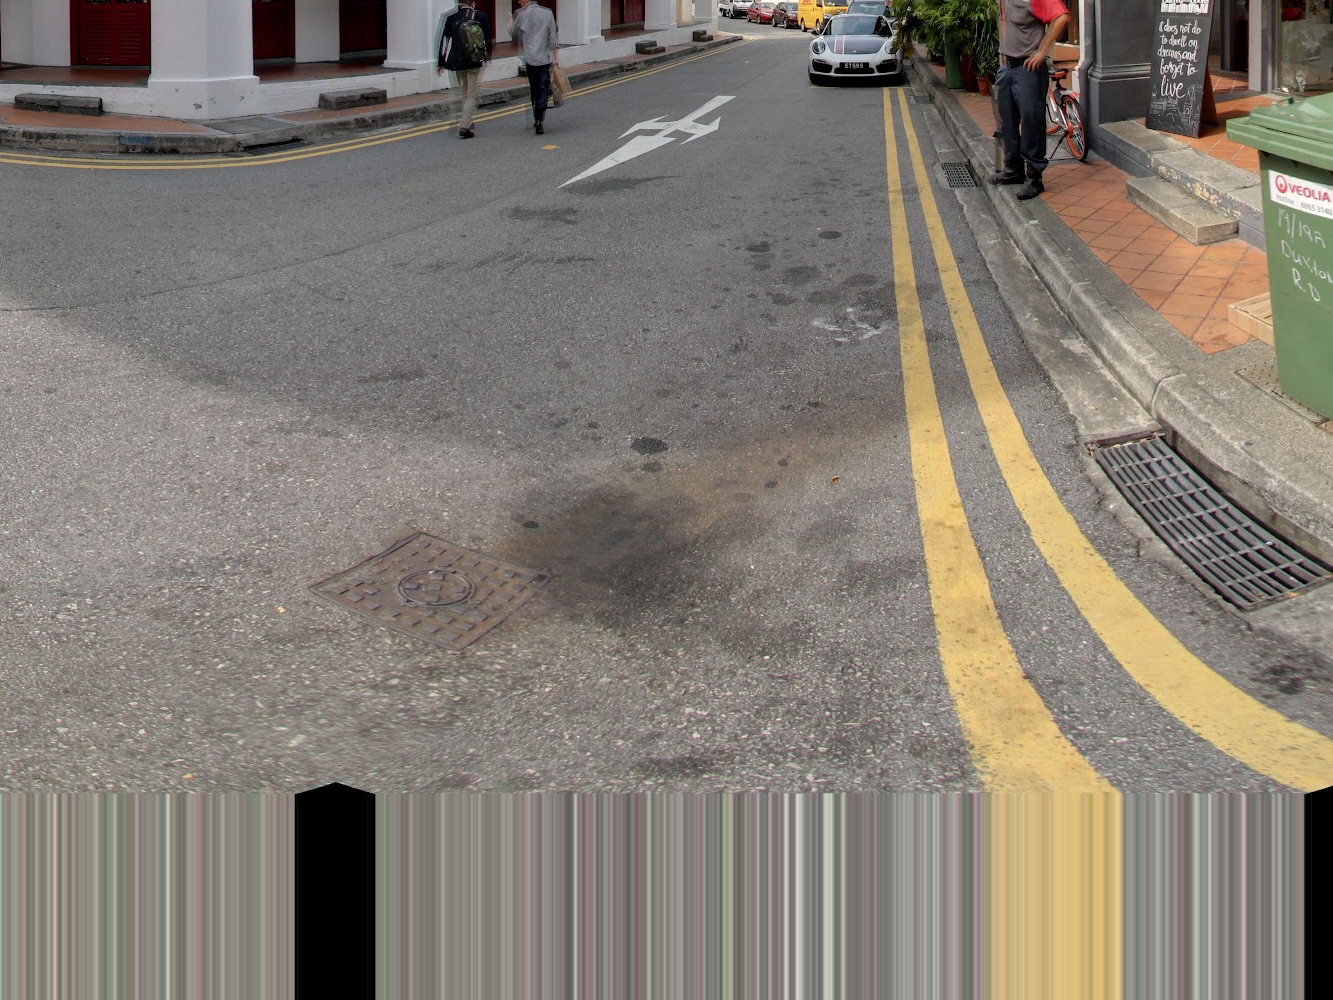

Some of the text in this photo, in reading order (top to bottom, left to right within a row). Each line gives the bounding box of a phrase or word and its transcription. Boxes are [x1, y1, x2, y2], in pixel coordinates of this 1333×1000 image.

[1163, 18, 1179, 35] does
[1179, 22, 1192, 34] not
[1191, 19, 1202, 35] do
[1159, 34, 1199, 50] to dwell on
[1157, 45, 1197, 62] dreams and
[1186, 61, 1198, 76] to
[1160, 75, 1186, 99] live
[1288, 182, 1332, 203] VEOLIA
[1275, 193, 1296, 206] Hotline
[1300, 201, 1316, 212] 6865
